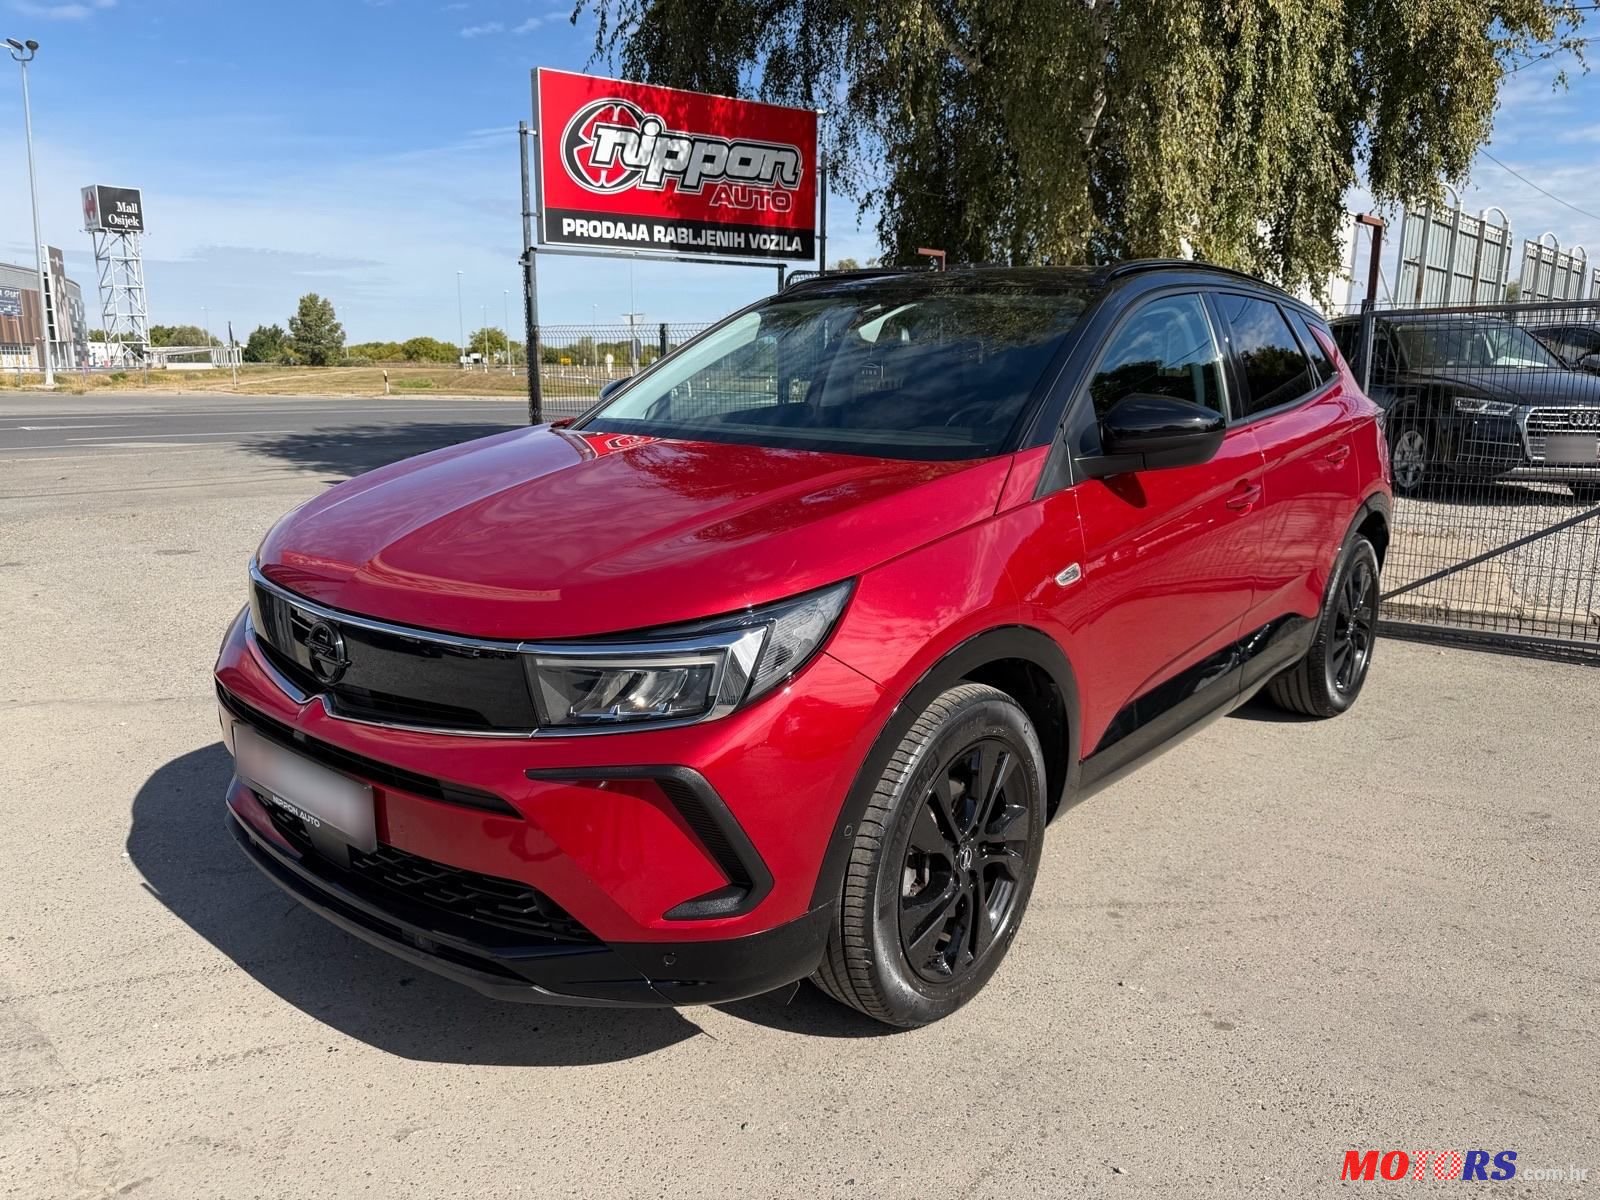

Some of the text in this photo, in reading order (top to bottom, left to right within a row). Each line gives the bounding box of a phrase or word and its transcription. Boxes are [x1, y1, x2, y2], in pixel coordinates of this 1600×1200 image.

[116, 201, 139, 214] Mall
[710, 185, 792, 212] AUTO
[108, 213, 140, 228] Osijek
[562, 217, 803, 252] PRODAJA RABLJENIH VOZILA
[272, 794, 321, 828] NIPPON AUTO
